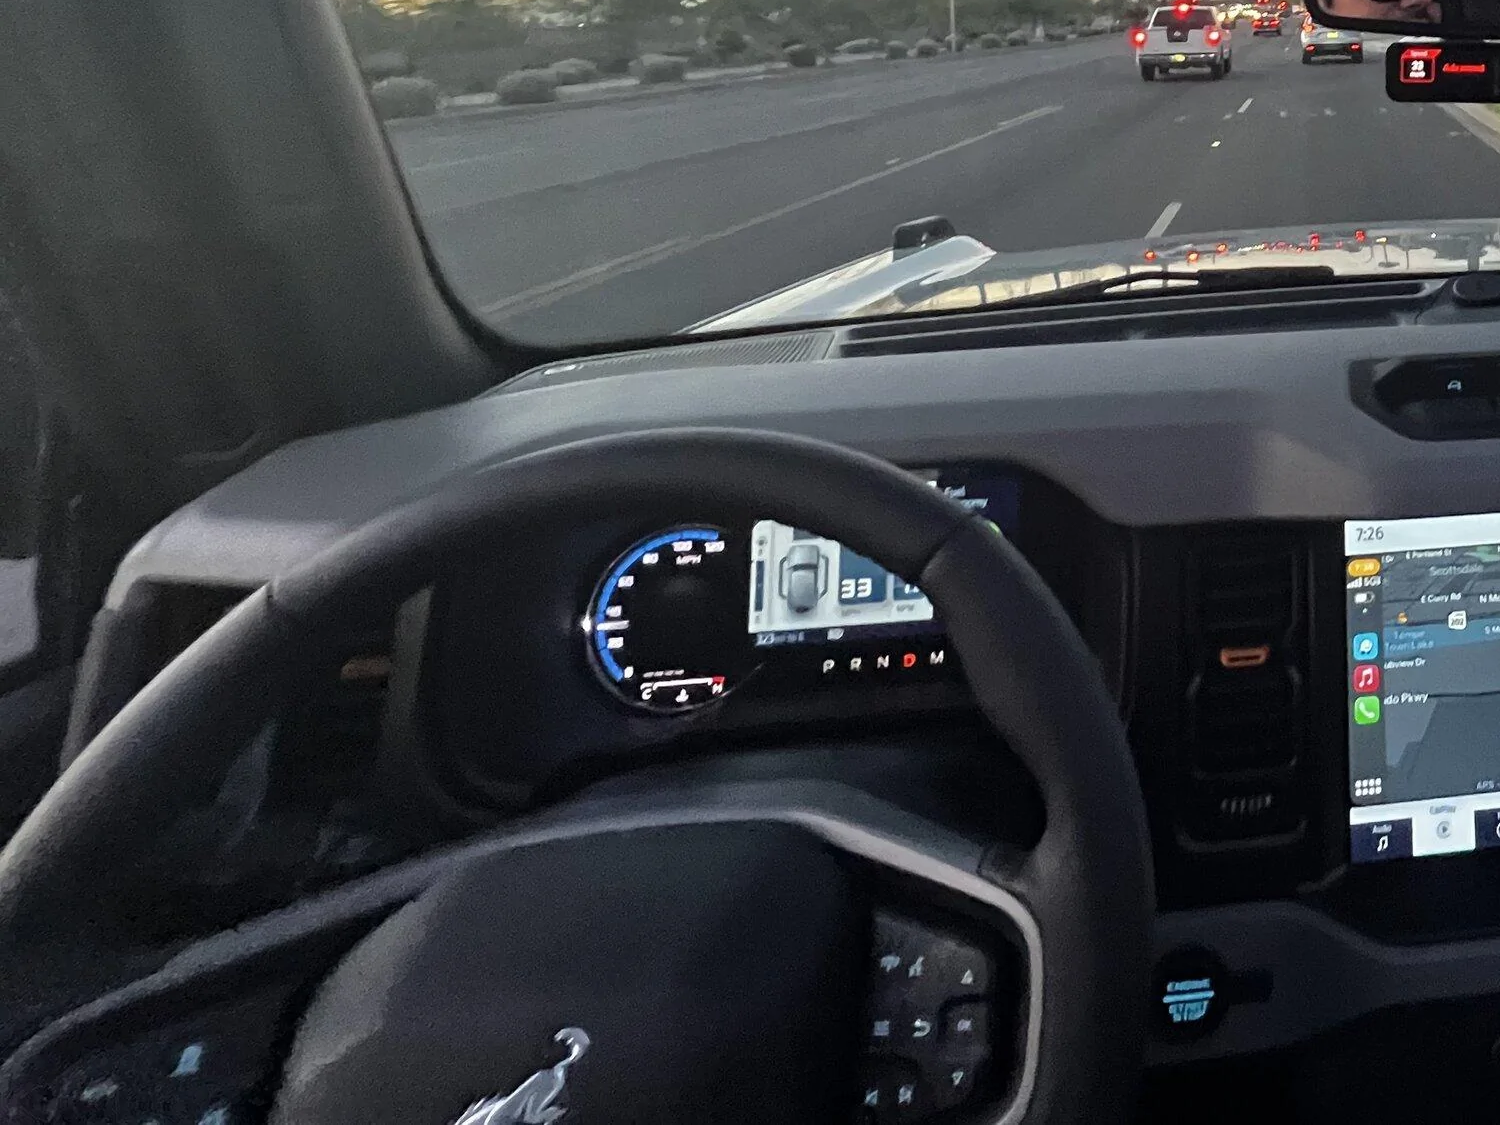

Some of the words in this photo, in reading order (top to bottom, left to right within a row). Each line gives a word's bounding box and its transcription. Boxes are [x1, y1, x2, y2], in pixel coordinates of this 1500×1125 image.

[1355, 526, 1385, 542] 7:26
[1429, 563, 1484, 576] Scottsdale
[841, 577, 873, 599] 33
[823, 658, 835, 674] P
[850, 657, 862, 671] R
[877, 654, 890, 669] N
[903, 653, 916, 667] D
[930, 650, 944, 665] M
[1401, 692, 1429, 704] Pkwy
